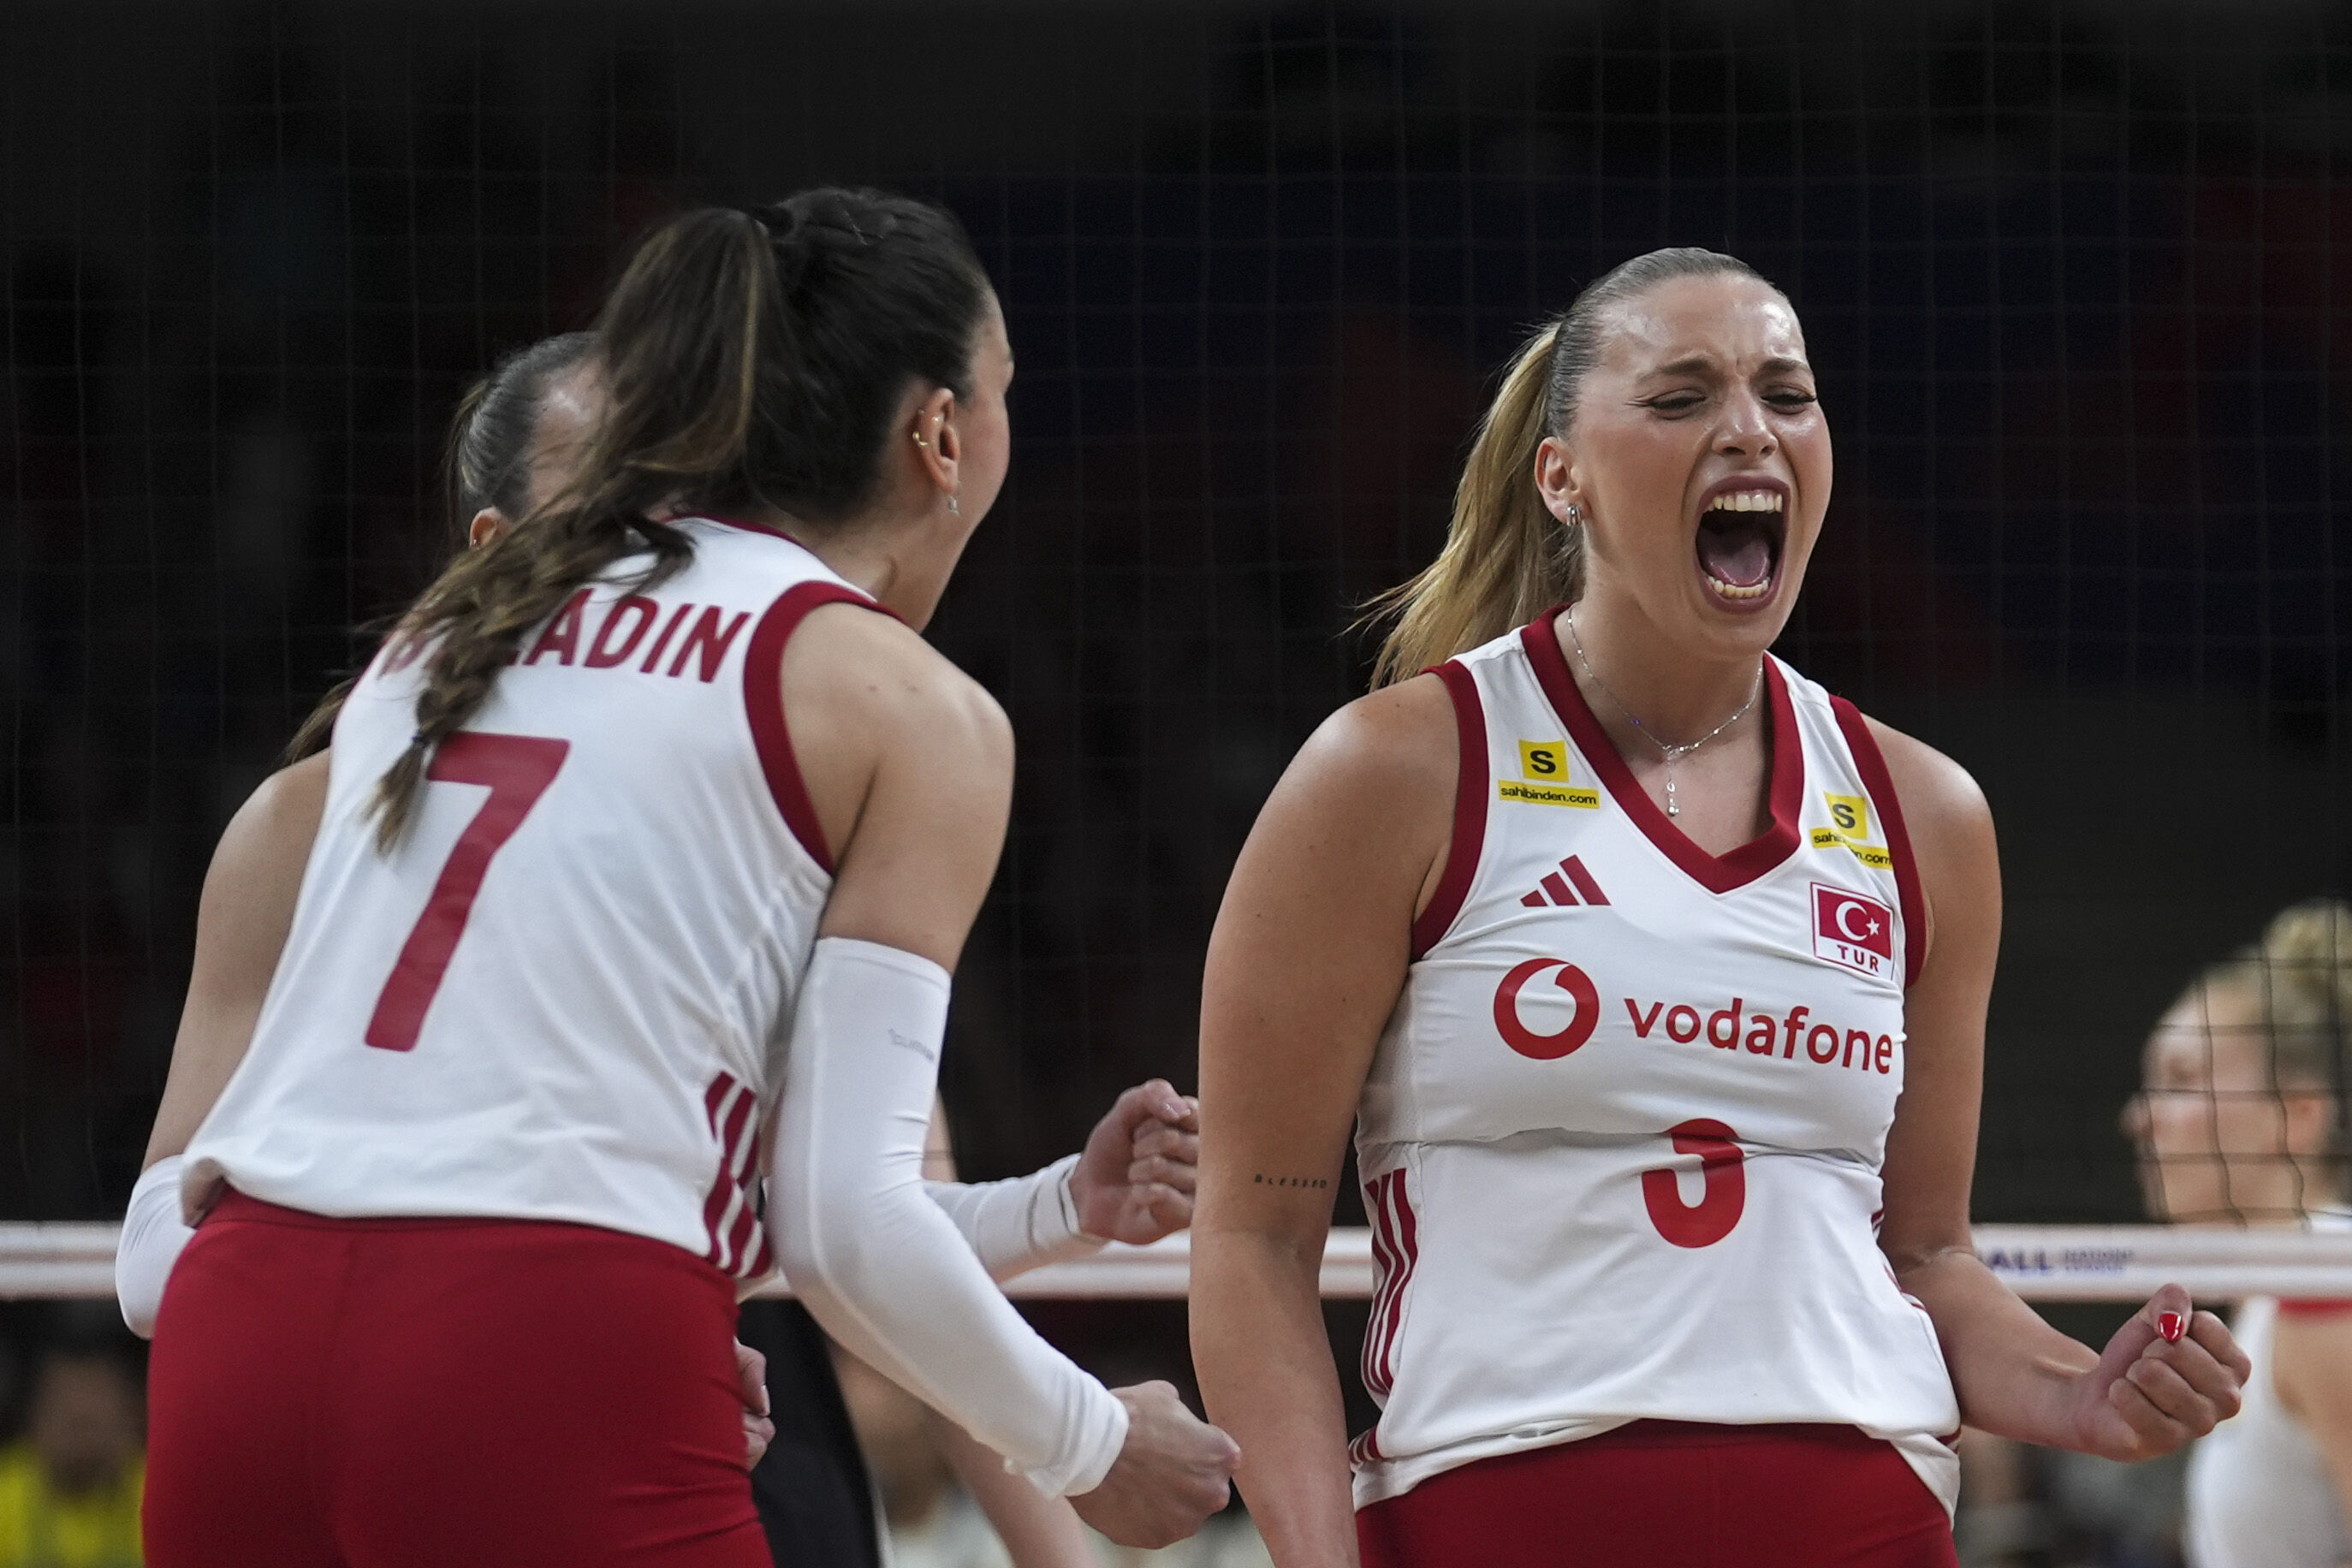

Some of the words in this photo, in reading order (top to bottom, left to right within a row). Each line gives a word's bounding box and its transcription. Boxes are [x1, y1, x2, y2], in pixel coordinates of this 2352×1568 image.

[1500, 786, 1597, 805] sahibinden.com
[363, 731, 571, 1052] 7
[1837, 944, 1879, 972] TUR
[1624, 997, 1893, 1075] vodafone
[1641, 1118, 1746, 1248] 3
